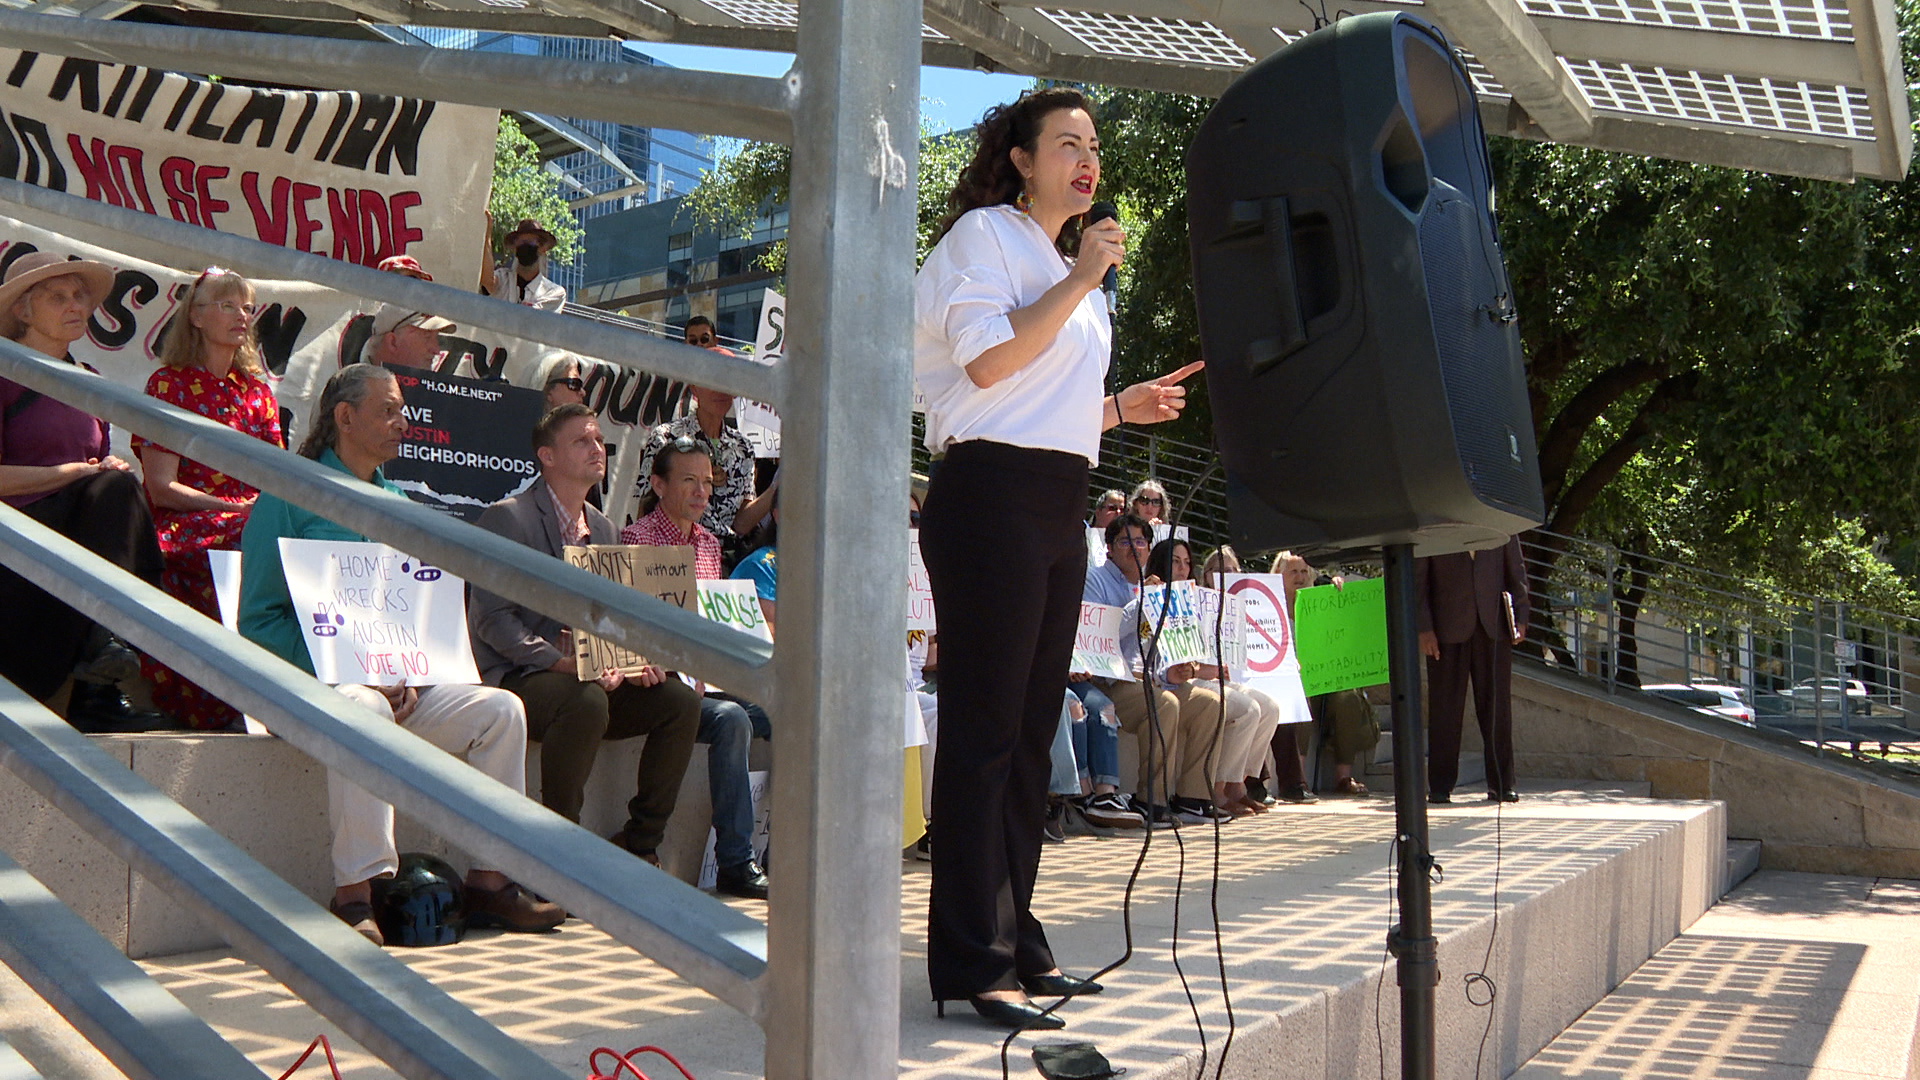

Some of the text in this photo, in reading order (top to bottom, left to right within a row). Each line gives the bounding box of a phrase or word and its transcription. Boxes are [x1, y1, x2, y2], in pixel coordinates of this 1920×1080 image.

[67, 132, 158, 216] NO
[159, 156, 231, 232] SE
[241, 171, 424, 270] VENDE
[401, 404, 433, 424] AVE
[401, 426, 451, 445] USTIN
[645, 561, 688, 577] without
[333, 588, 410, 613] WRECKS
[697, 589, 764, 629] HOUSE
[1301, 588, 1384, 616] AFFORDABILITY
[1079, 603, 1107, 629] TECT
[352, 620, 419, 648] AUSTIN
[1326, 627, 1346, 645] NOT
[354, 651, 430, 678] VOTE NO
